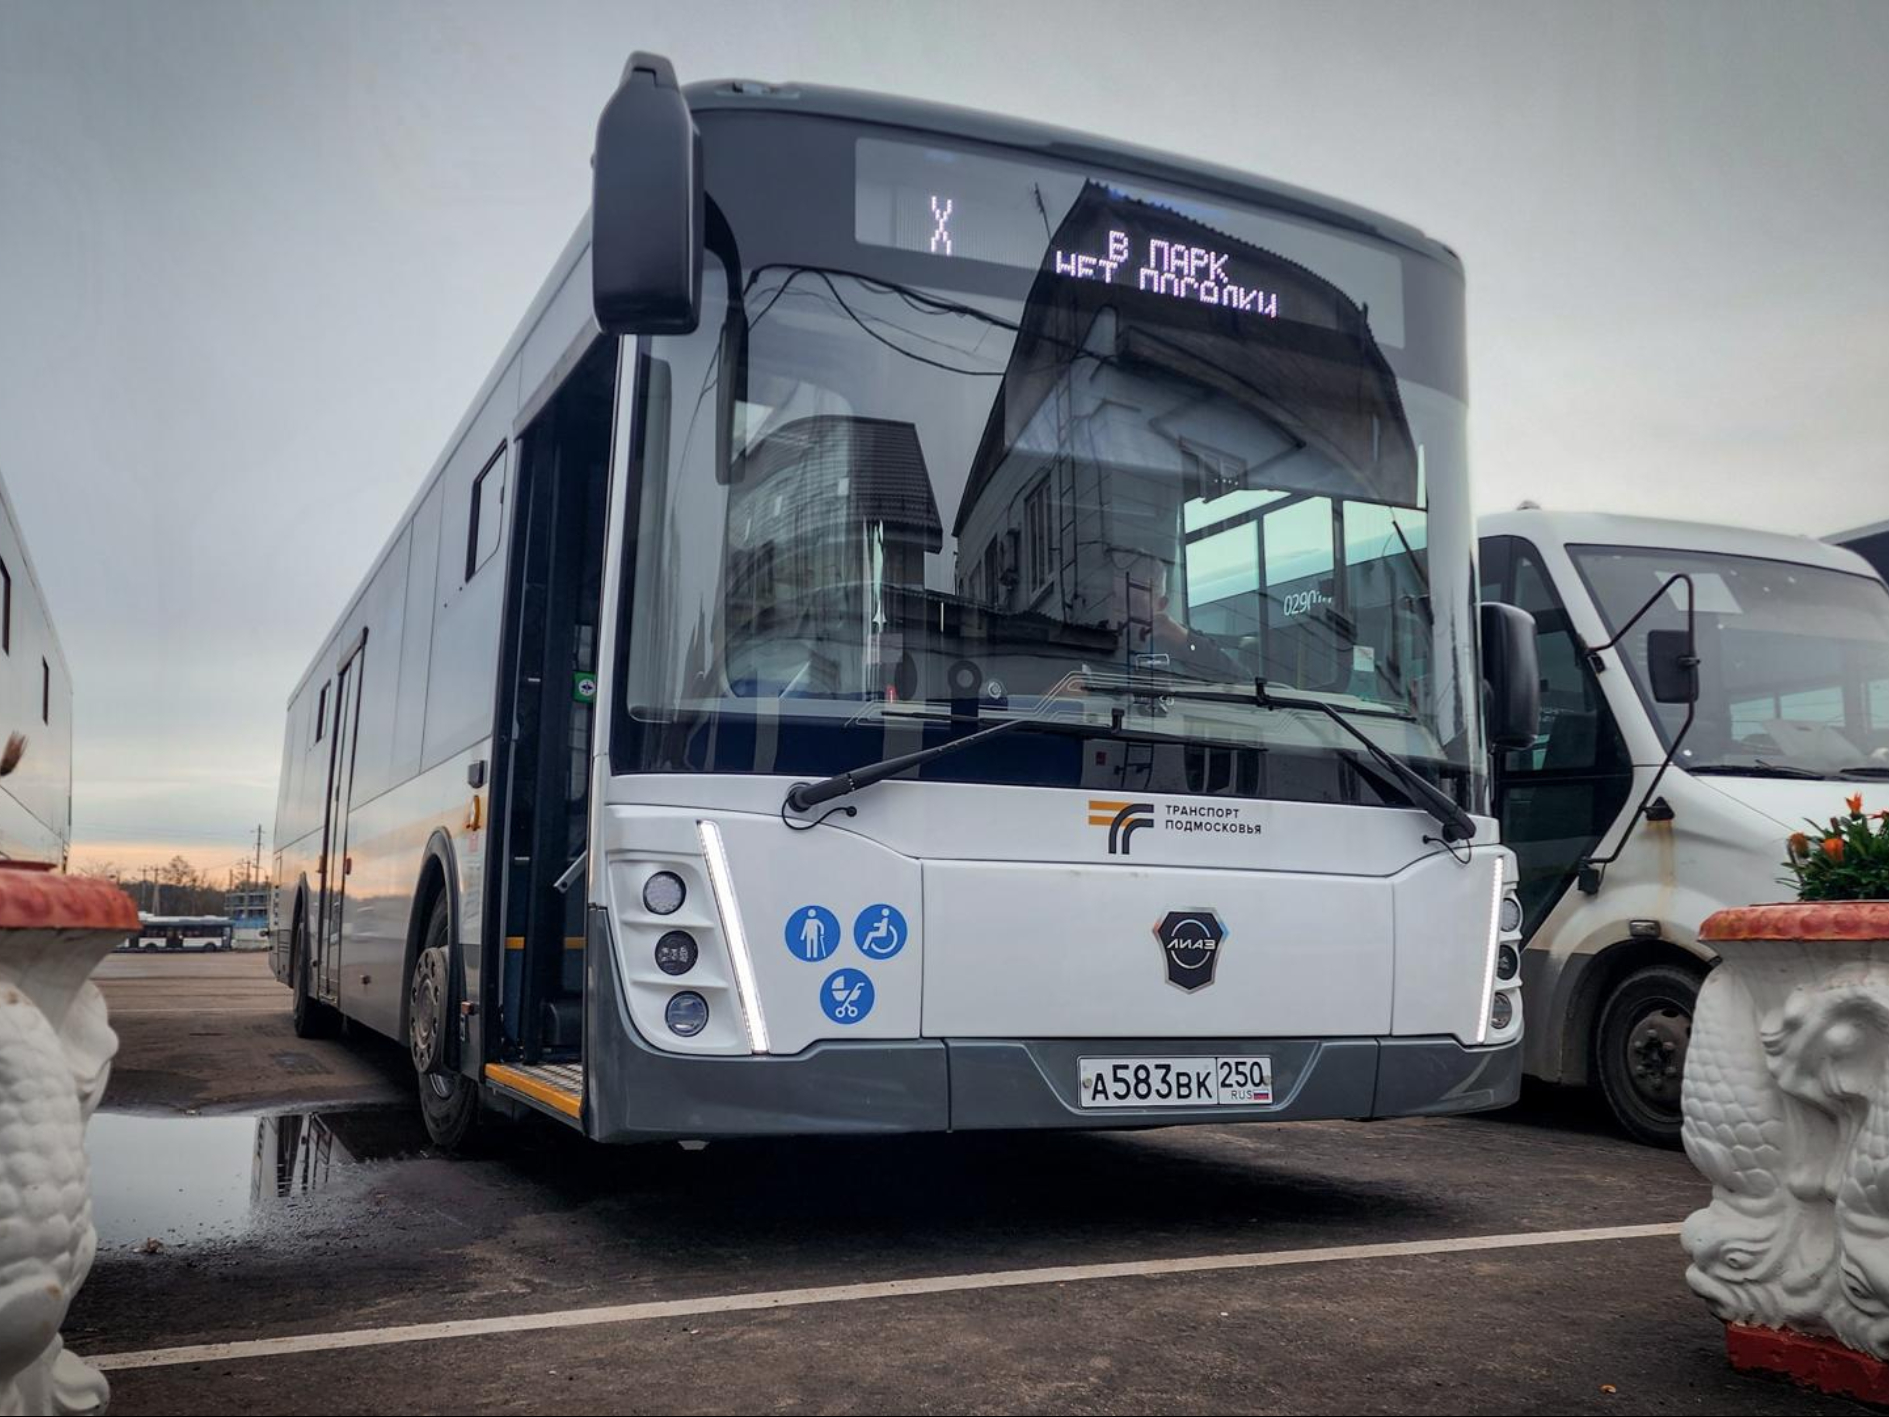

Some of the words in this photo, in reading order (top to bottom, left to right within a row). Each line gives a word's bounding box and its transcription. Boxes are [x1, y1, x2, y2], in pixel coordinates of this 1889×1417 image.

[1109, 230, 1129, 262] В
[1150, 239, 1229, 283] ПАРК
[1056, 251, 1118, 283] НЕТ
[1165, 805, 1239, 818] ТРАНСПОРТ
[1165, 820, 1262, 835] ПОДМОСКОВЬЯ
[1166, 939, 1216, 950] ЛИАЗ
[1219, 1061, 1263, 1088] 250
[1231, 1090, 1253, 1100] RUS
